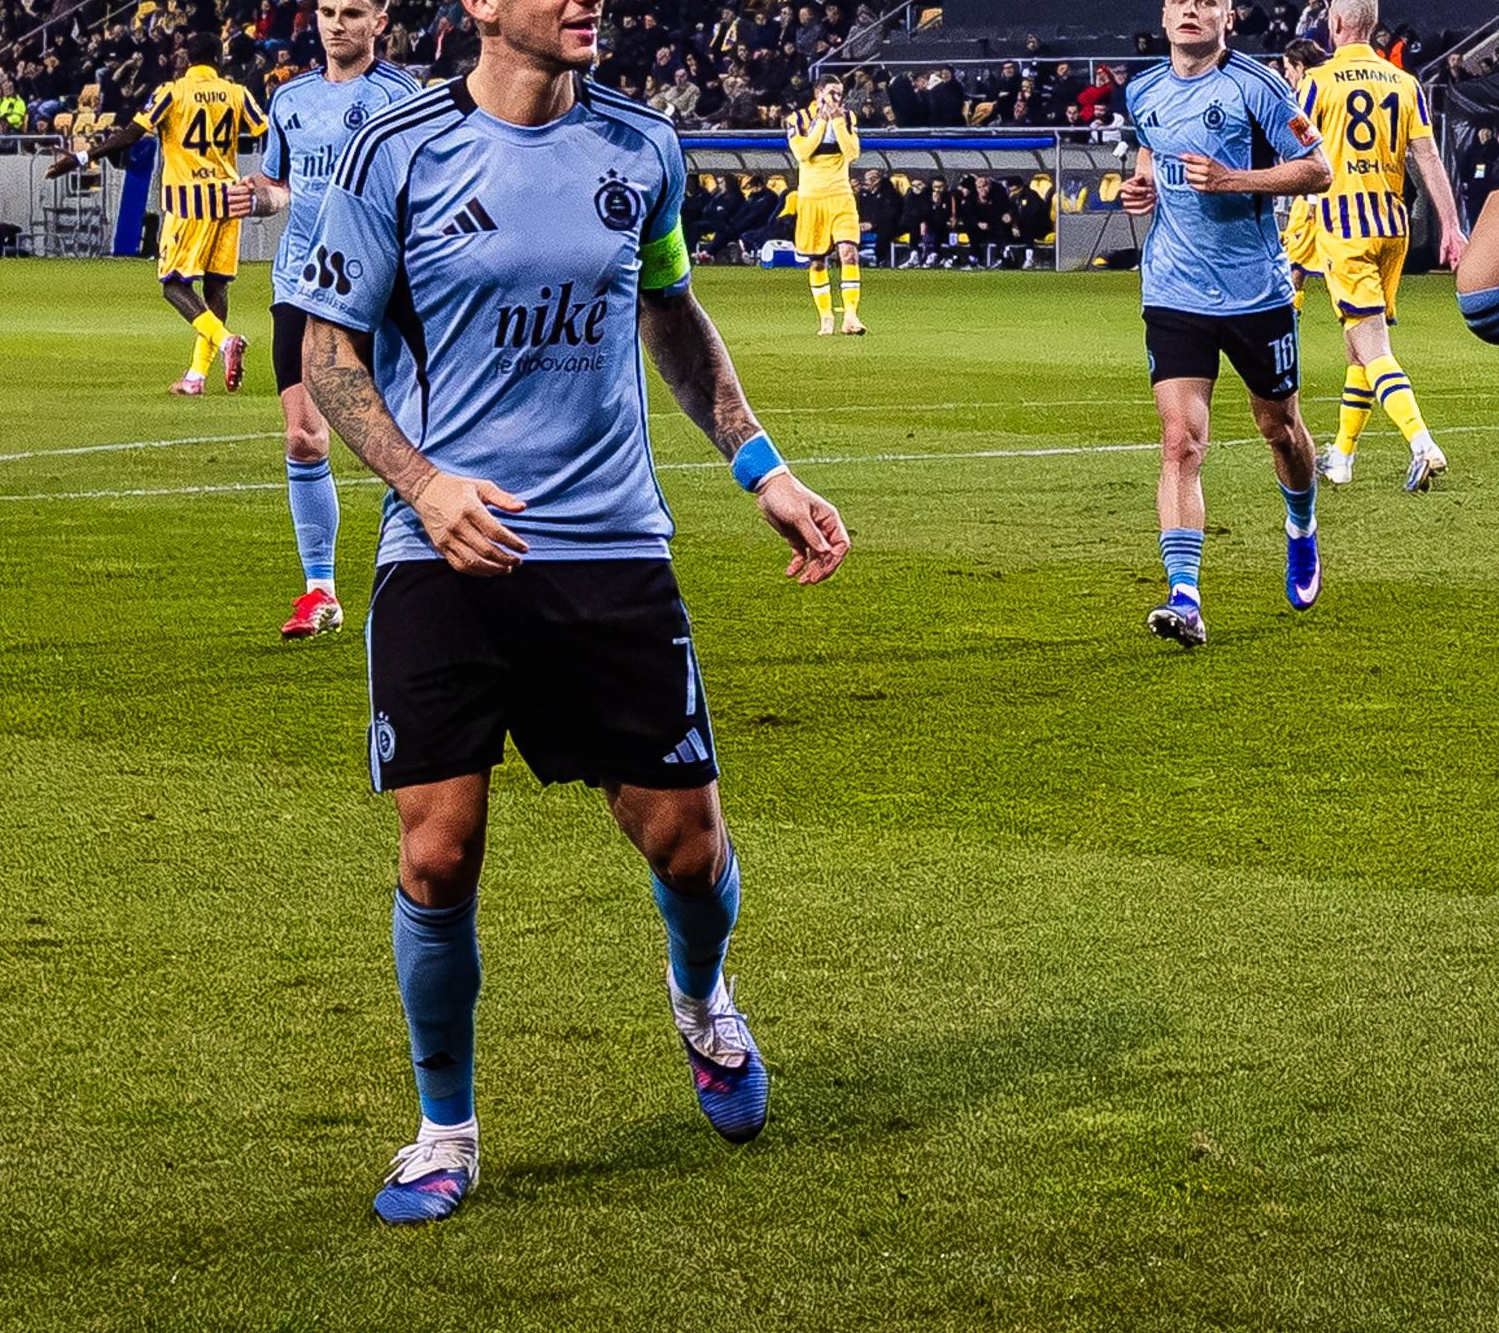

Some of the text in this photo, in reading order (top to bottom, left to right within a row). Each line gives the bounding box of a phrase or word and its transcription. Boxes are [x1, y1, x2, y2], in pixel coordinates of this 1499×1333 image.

[182, 106, 234, 157] 44
[1346, 89, 1399, 153] 81
[302, 144, 340, 178] nik
